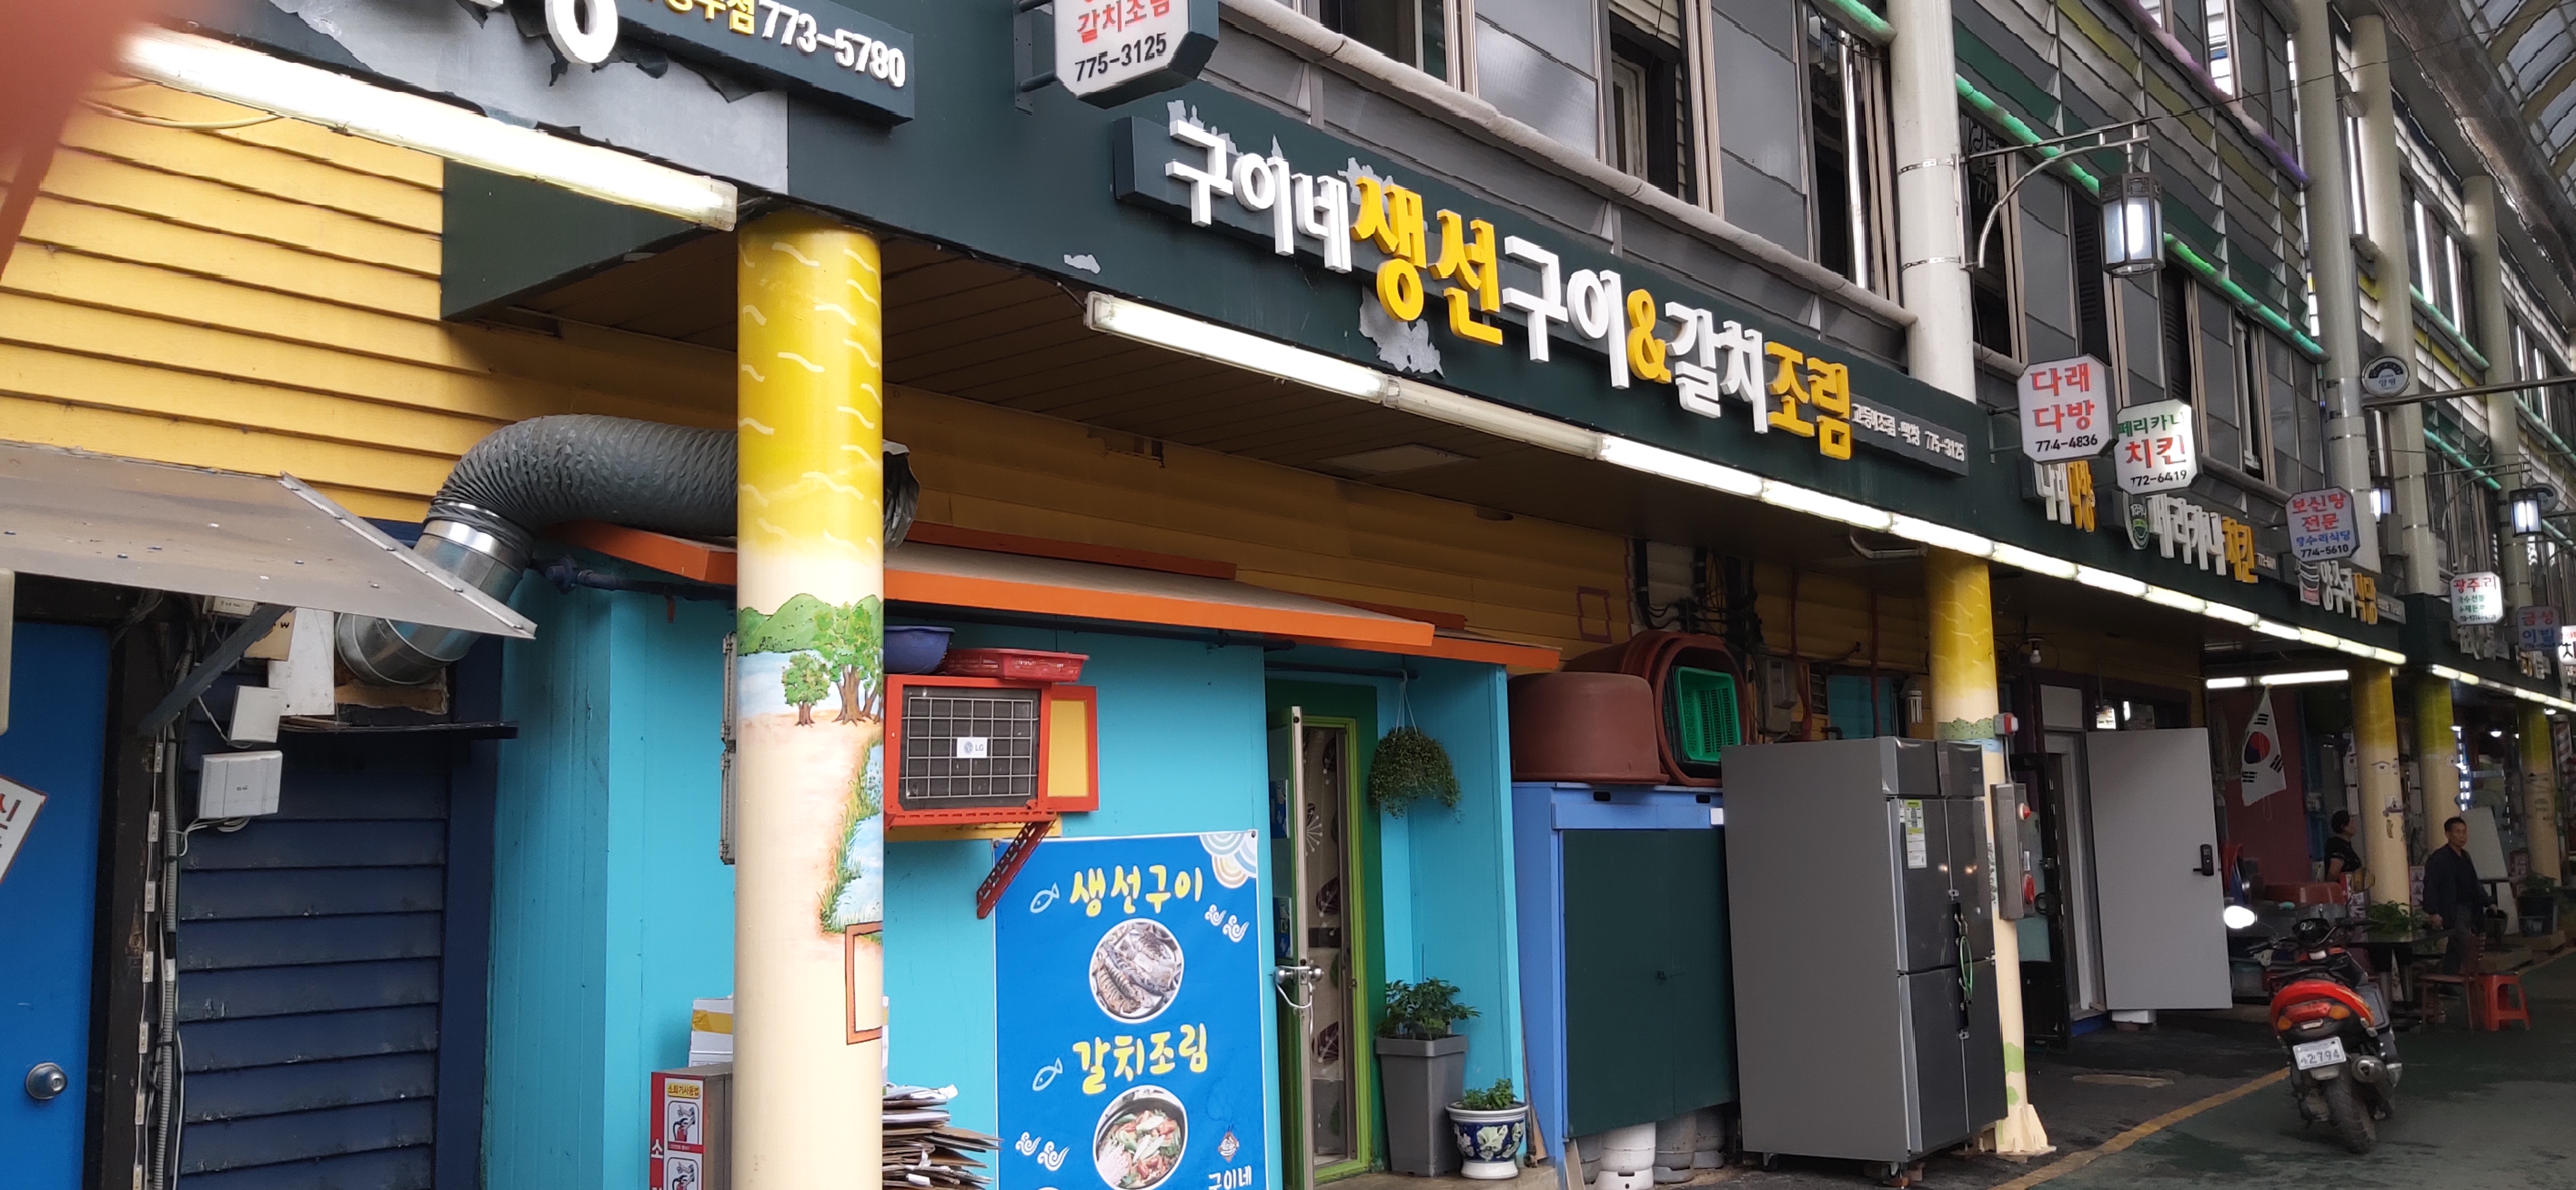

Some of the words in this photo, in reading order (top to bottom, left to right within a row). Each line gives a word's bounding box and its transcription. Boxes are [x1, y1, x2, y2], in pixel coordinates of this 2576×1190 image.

[758, 0, 906, 87] 773-5780
[1075, 32, 1167, 82] 775-3125
[2030, 363, 2090, 397] 다래
[2032, 399, 2095, 433] 다방
[1924, 430, 1965, 462] 775-3125
[2035, 434, 2098, 453] 774-4836
[2125, 434, 2187, 469] 치킨
[2130, 469, 2187, 489] 772-6419
[2292, 493, 2346, 514] 보신탕
[2302, 513, 2339, 532] 전문
[2300, 544, 2349, 558] 774-5610
[2453, 576, 2497, 594] 광주리
[975, 743, 984, 752] LG
[1069, 864, 1203, 918] 생선구이
[1072, 1022, 1208, 1095] 갈치조림
[1208, 1165, 1253, 1190] 구이네
